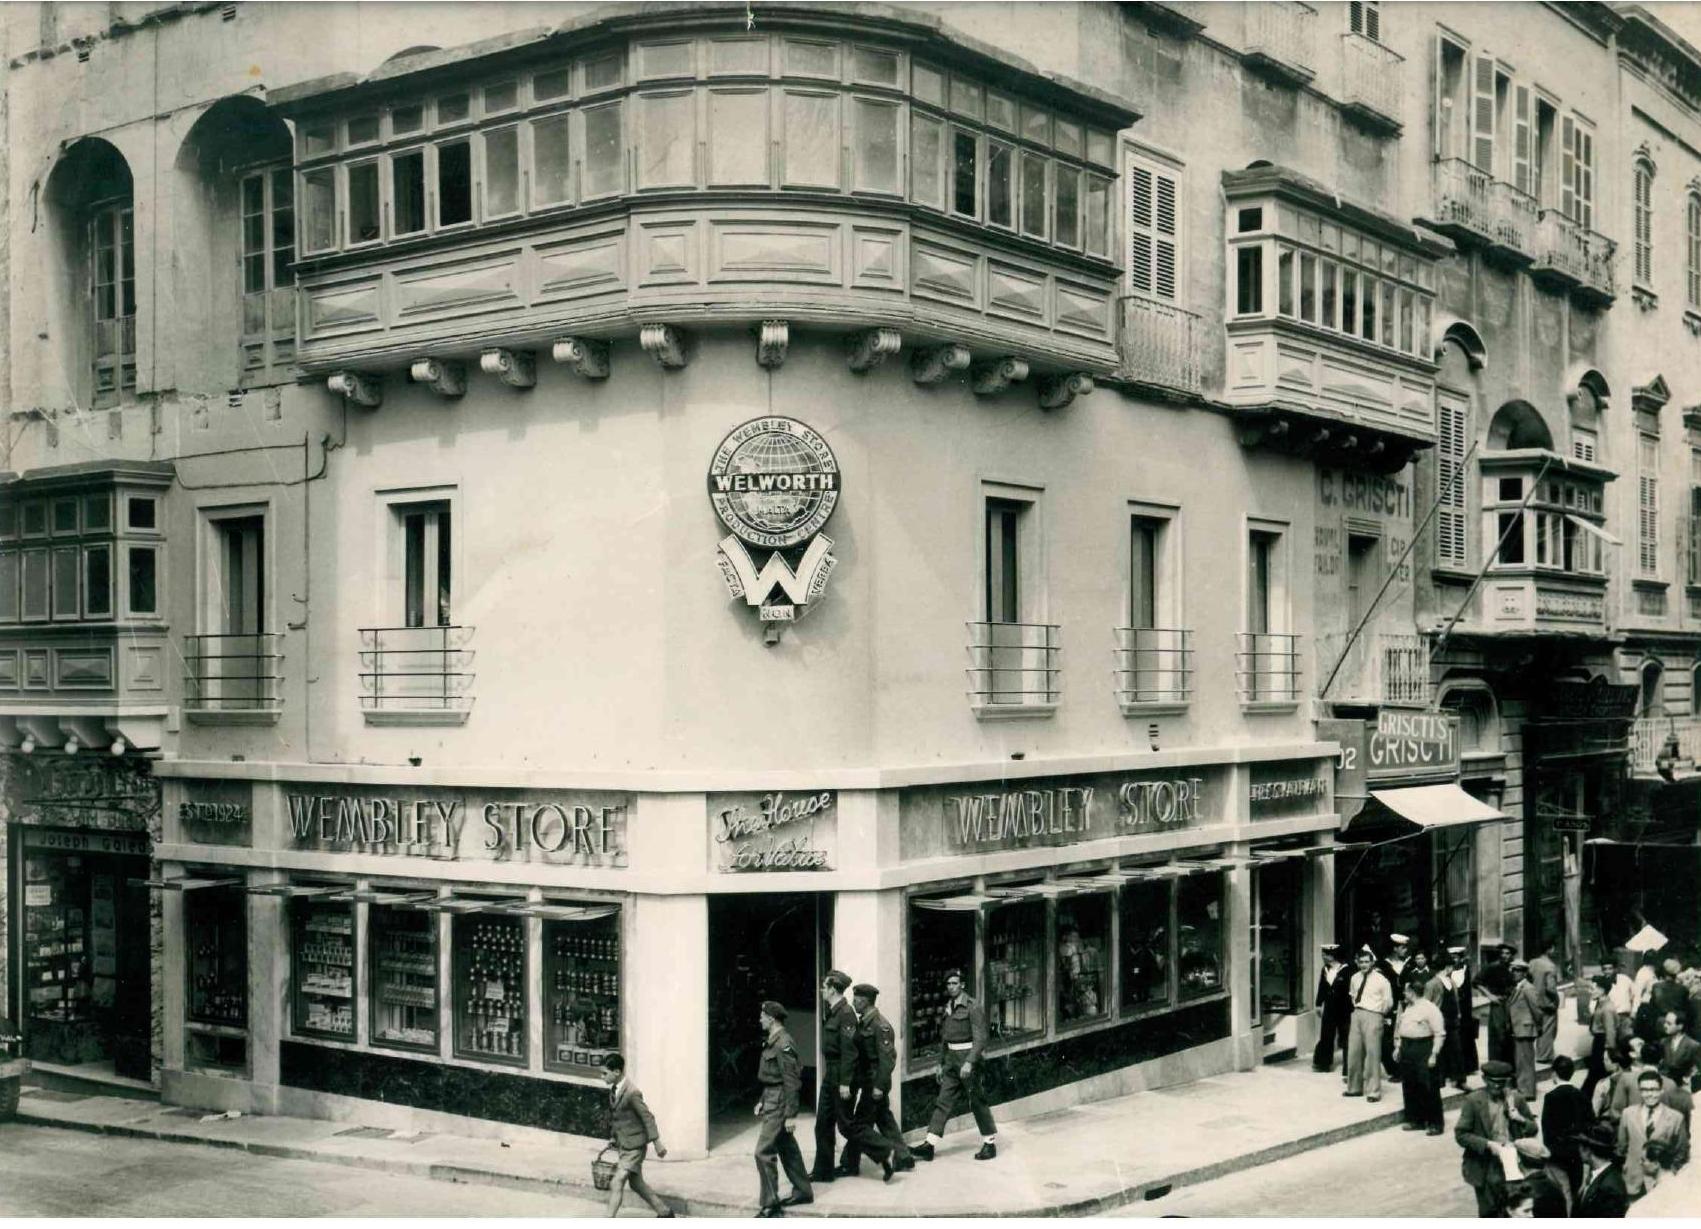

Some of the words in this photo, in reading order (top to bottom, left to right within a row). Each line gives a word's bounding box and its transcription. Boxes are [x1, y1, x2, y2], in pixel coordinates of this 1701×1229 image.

[714, 446, 732, 473] THE
[733, 420, 791, 443] WEMBLEY
[715, 474, 833, 491] WELWORTH
[1342, 472, 1410, 519] GRISCTI
[716, 497, 787, 545] PRODUCTION
[798, 490, 834, 540] CENTRE
[286, 794, 460, 849] WEMBLEY
[482, 802, 630, 857] STORE
[715, 804, 768, 843] The
[760, 791, 832, 825] House
[950, 786, 1094, 843] WEMBLEY
[1119, 777, 1203, 827] STORE
